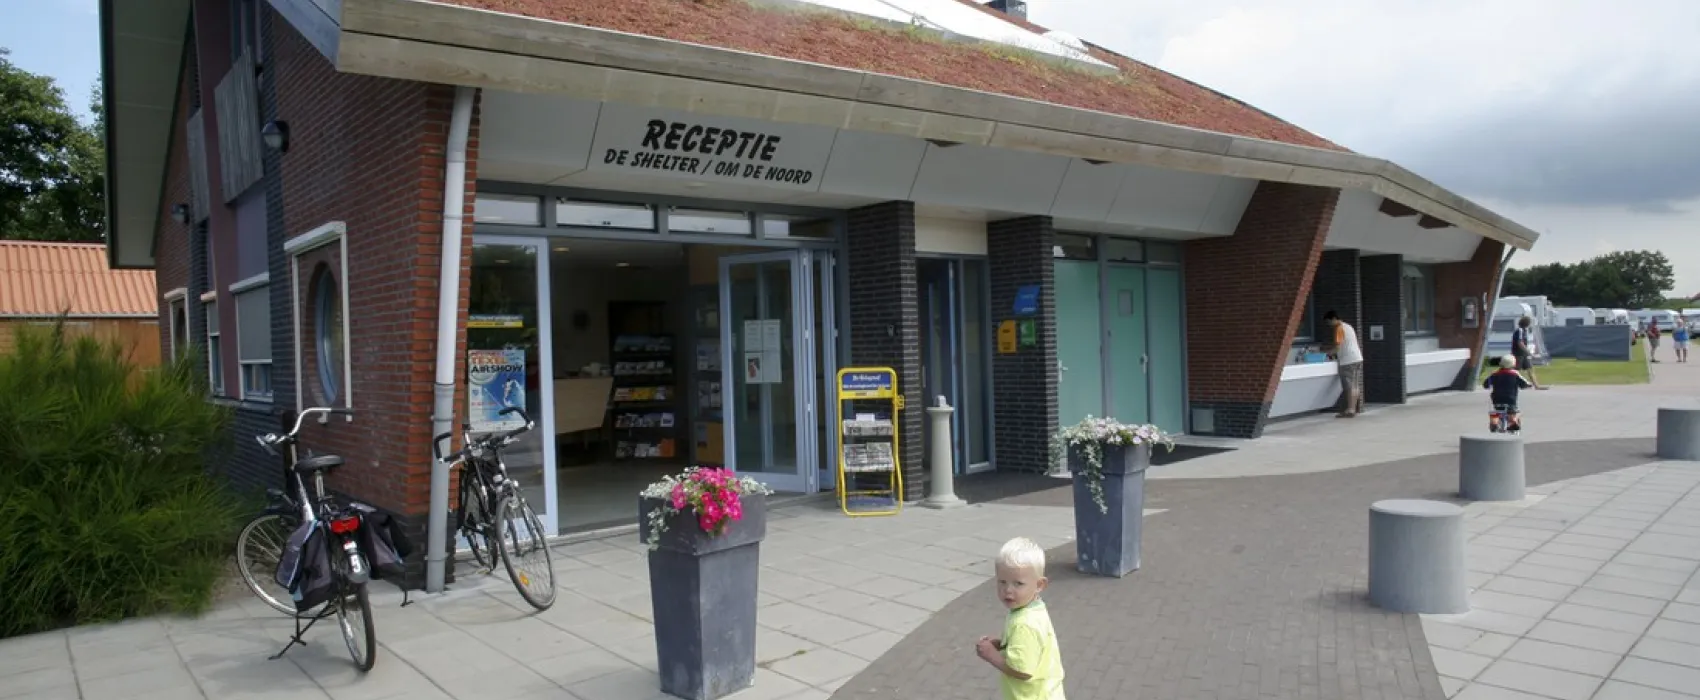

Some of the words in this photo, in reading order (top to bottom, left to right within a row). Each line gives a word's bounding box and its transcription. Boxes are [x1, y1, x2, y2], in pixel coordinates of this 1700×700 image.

[641, 119, 781, 161] RECEPTIE
[604, 148, 629, 165] DE
[630, 151, 700, 174] SHELTER
[715, 161, 741, 177] OM
[742, 165, 765, 180] DE
[765, 166, 812, 184] NOORD
